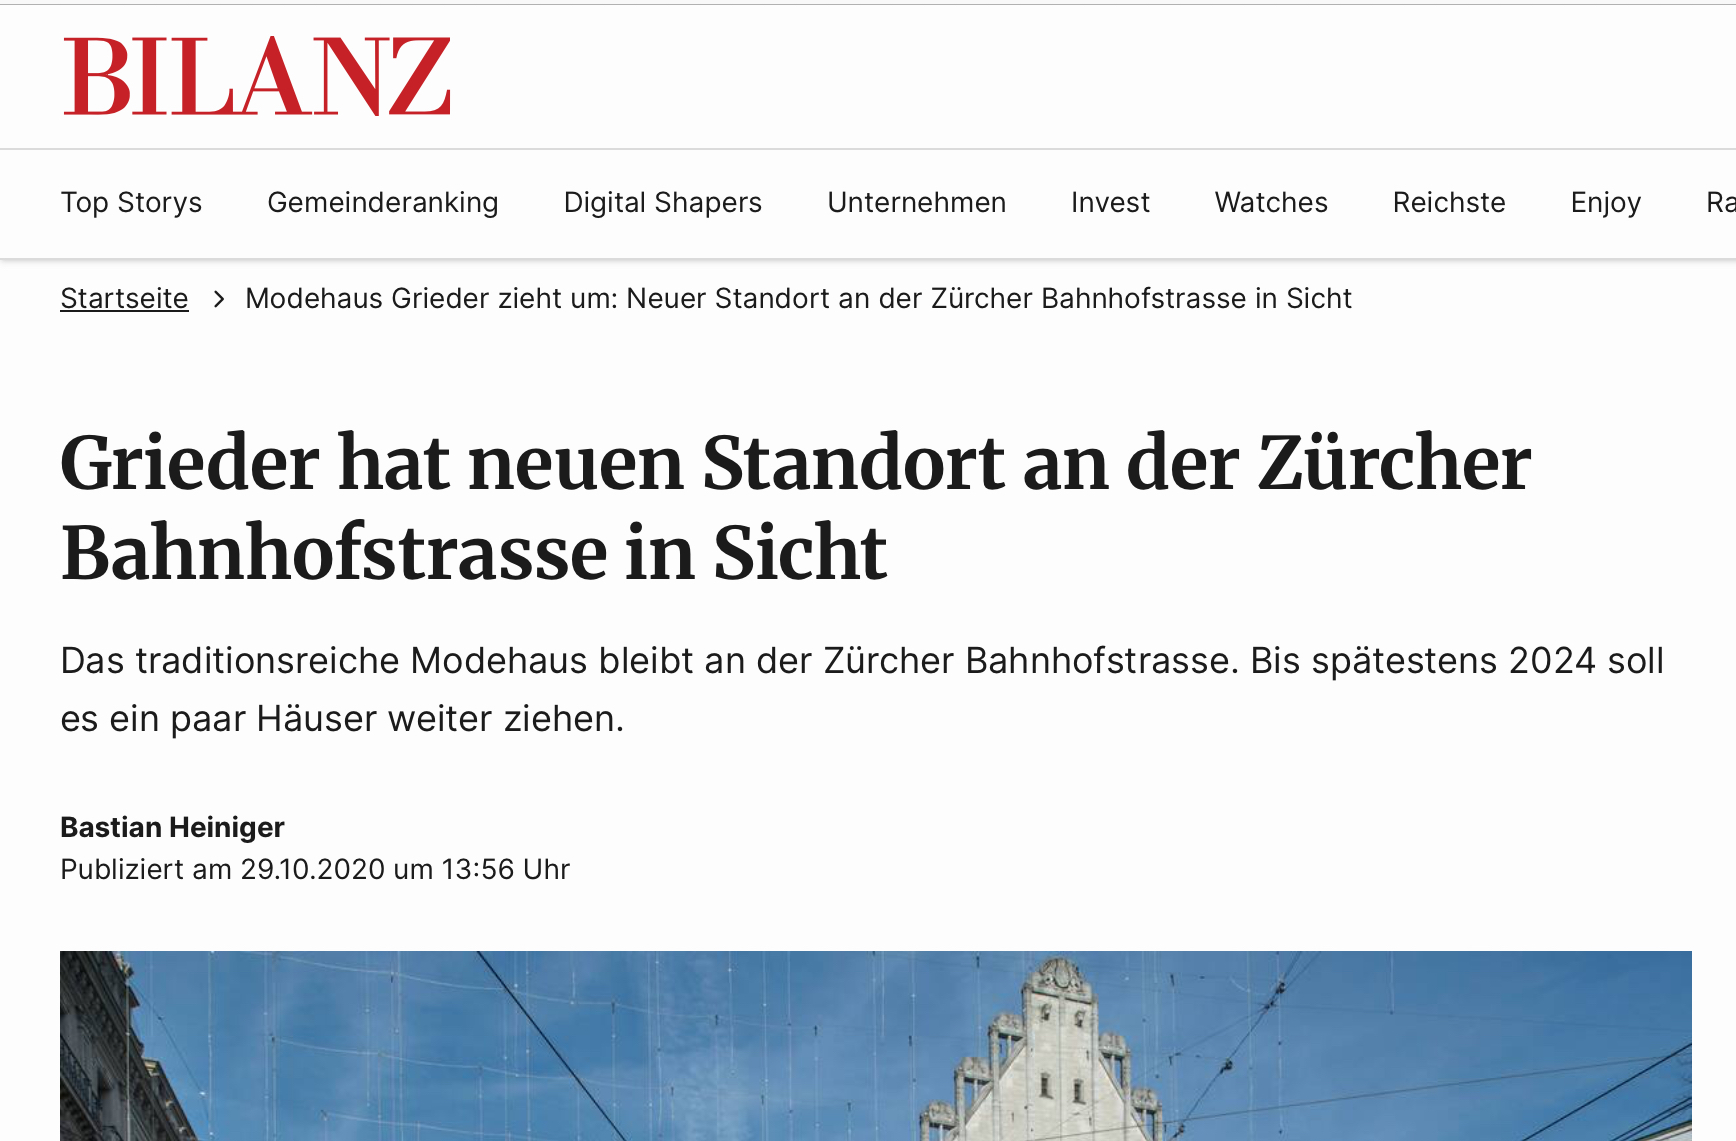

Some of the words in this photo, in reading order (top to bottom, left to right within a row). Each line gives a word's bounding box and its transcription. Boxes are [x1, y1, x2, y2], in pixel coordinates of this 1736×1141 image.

[64, 36, 450, 116] BILANZ
[61, 191, 108, 218] Top
[119, 191, 201, 218] Storys
[269, 191, 497, 218] Gemeinderanking
[566, 191, 644, 218] Digital
[656, 191, 761, 218] Shapers
[829, 191, 1005, 213] Unternehmen
[1073, 191, 1150, 212] Invest
[1215, 191, 1327, 213] Watches
[1395, 191, 1505, 213] Reichste
[1573, 191, 1641, 218] Enjoy
[62, 287, 188, 309] Startseite
[247, 287, 382, 309] Modehaus
[393, 287, 489, 309] Grieder
[499, 287, 561, 309] zieht
[572, 292, 616, 308] um:
[628, 287, 706, 309] Neuer
[716, 287, 829, 309] Standort
[839, 292, 868, 309] an
[880, 287, 922, 308] der
[932, 287, 1033, 309] Zürcher
[1043, 287, 1246, 309] Bahnhofstrasse
[1257, 287, 1276, 308] in
[1288, 287, 1352, 308] Sicht
[62, 430, 319, 490] Grieder
[338, 430, 450, 490] hat
[469, 448, 684, 490] neuen
[705, 430, 1005, 490] Standort
[1024, 448, 1109, 490] an
[1128, 430, 1239, 490] der
[1258, 430, 1531, 490] Zürcher
[62, 519, 606, 580] Bahnhofstrasse
[626, 521, 695, 579] in
[716, 520, 887, 580] Sicht
[63, 647, 123, 674] Das
[136, 646, 398, 674] traditionsreiche
[413, 647, 586, 674] Modehaus
[601, 646, 693, 674] bleibt
[706, 653, 744, 674] an
[758, 647, 812, 674] der
[825, 646, 954, 674] Zürcher
[968, 645, 1237, 674] Bahnhofstrasse.
[1253, 646, 1299, 674] Bis
[1313, 646, 1496, 681] spätestens
[1510, 646, 1595, 674] 2024
[1609, 647, 1662, 674] soll
[62, 711, 97, 732] es
[111, 704, 158, 732] ein
[173, 711, 246, 739] paar
[259, 704, 377, 732] Häuser
[388, 704, 492, 732] weiter
[505, 704, 622, 732] ziehen.
[62, 815, 161, 837] Bastian
[171, 815, 285, 843] Heiniger
[62, 858, 183, 879] Publiziert
[193, 863, 230, 880] am
[242, 858, 384, 879] 29.10.2020
[395, 863, 432, 879] um
[443, 858, 513, 879] 13:56
[525, 858, 570, 880] Uhr
